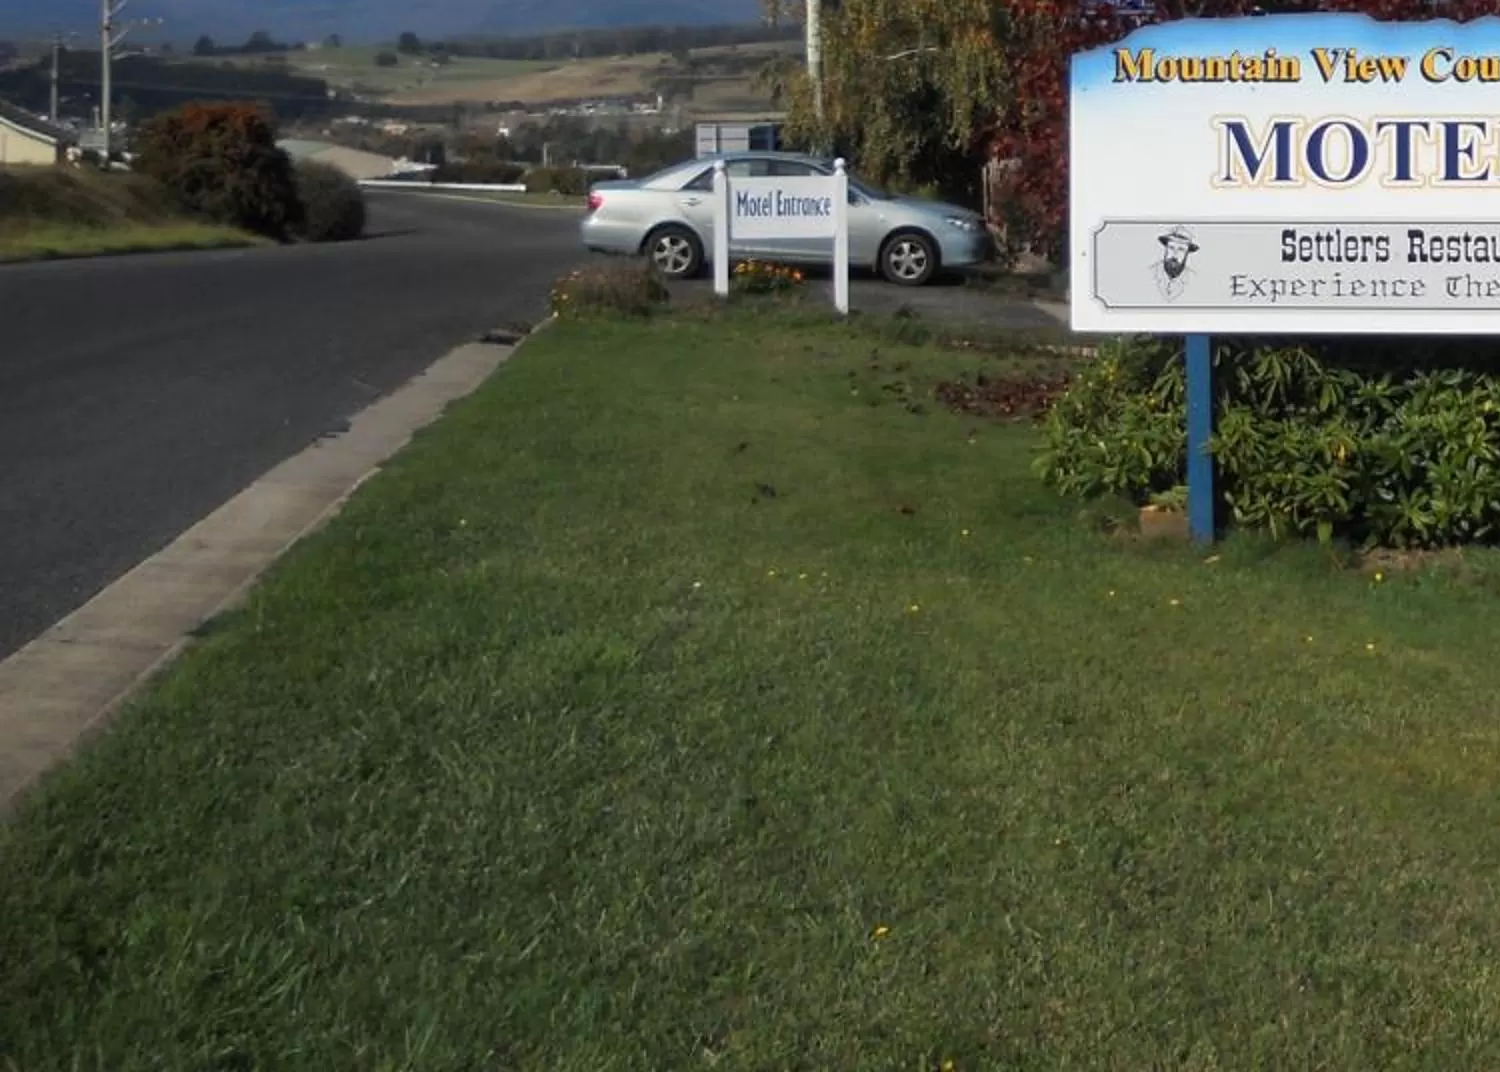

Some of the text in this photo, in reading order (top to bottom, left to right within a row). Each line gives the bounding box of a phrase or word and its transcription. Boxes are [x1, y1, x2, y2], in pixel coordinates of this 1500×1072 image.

[1112, 47, 1301, 83] Mountain
[1310, 47, 1410, 83] View
[736, 189, 831, 217] Motel Entrance
[1281, 229, 1391, 263] Settlers
[1230, 273, 1426, 303] Experience
[1444, 273, 1500, 299] The
